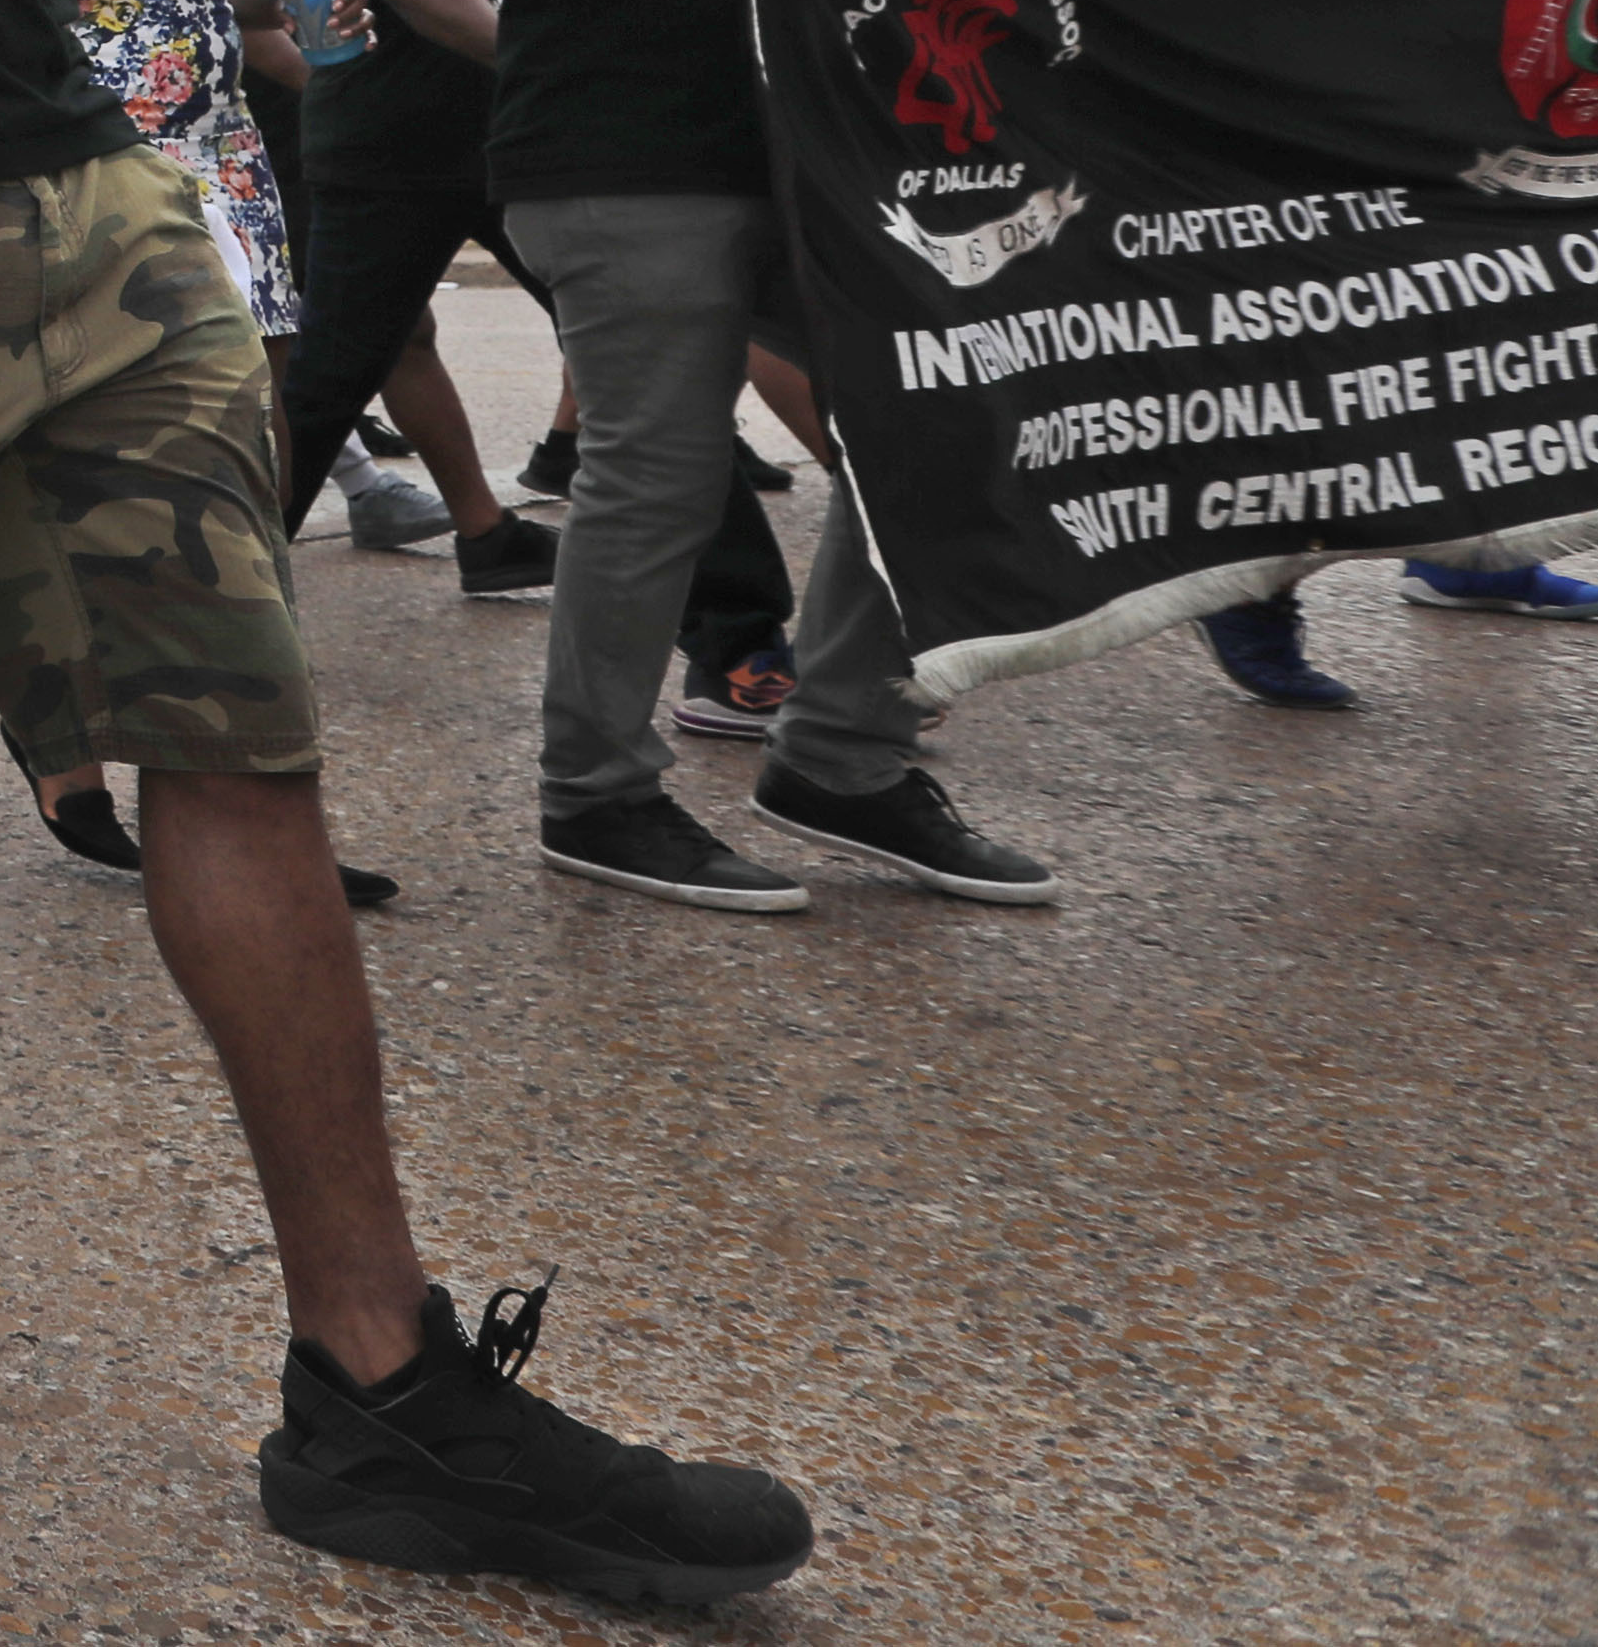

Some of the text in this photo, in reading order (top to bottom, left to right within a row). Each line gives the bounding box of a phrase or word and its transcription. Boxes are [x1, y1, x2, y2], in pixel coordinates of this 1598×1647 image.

[897, 161, 1026, 199] OF DALLAS
[1112, 186, 1425, 260] CHAPTER OF THE
[1211, 244, 1556, 346] ASSOCIATION
[1559, 229, 1598, 285] O
[1011, 322, 1598, 470] PROFESSIONAL FIRE FIGHT
[1049, 483, 1169, 558] SOUTH
[1197, 451, 1445, 531] CENTRAL
